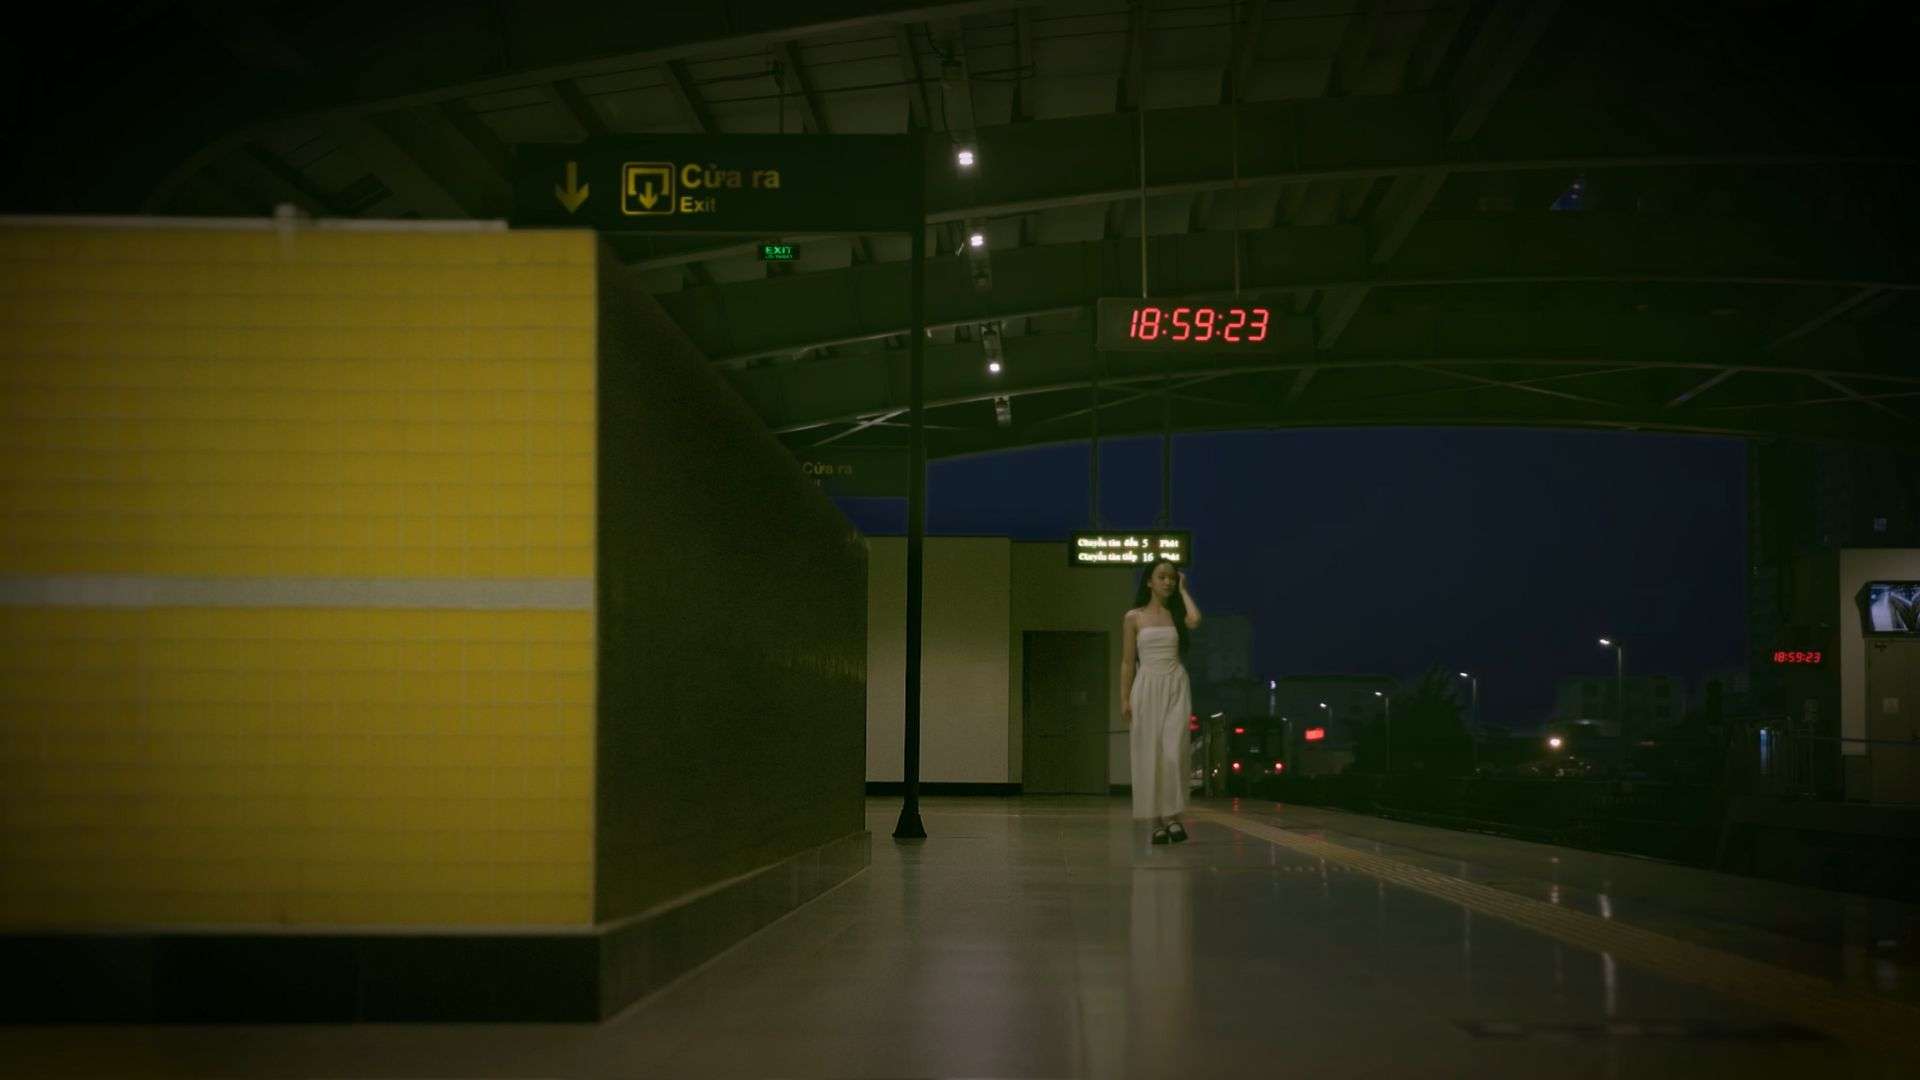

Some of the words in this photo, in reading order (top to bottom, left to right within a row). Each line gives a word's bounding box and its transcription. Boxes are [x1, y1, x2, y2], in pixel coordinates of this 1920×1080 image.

[680, 163, 742, 189] Cửa
[751, 169, 780, 189] ra
[680, 196, 717, 213] Exit
[765, 246, 793, 255] EXIT
[1129, 306, 1271, 343] 18:59:23
[838, 463, 853, 475] ra
[1142, 539, 1149, 548] 5
[1142, 552, 1154, 562] 16
[1774, 651, 1821, 663] 18:59:23
